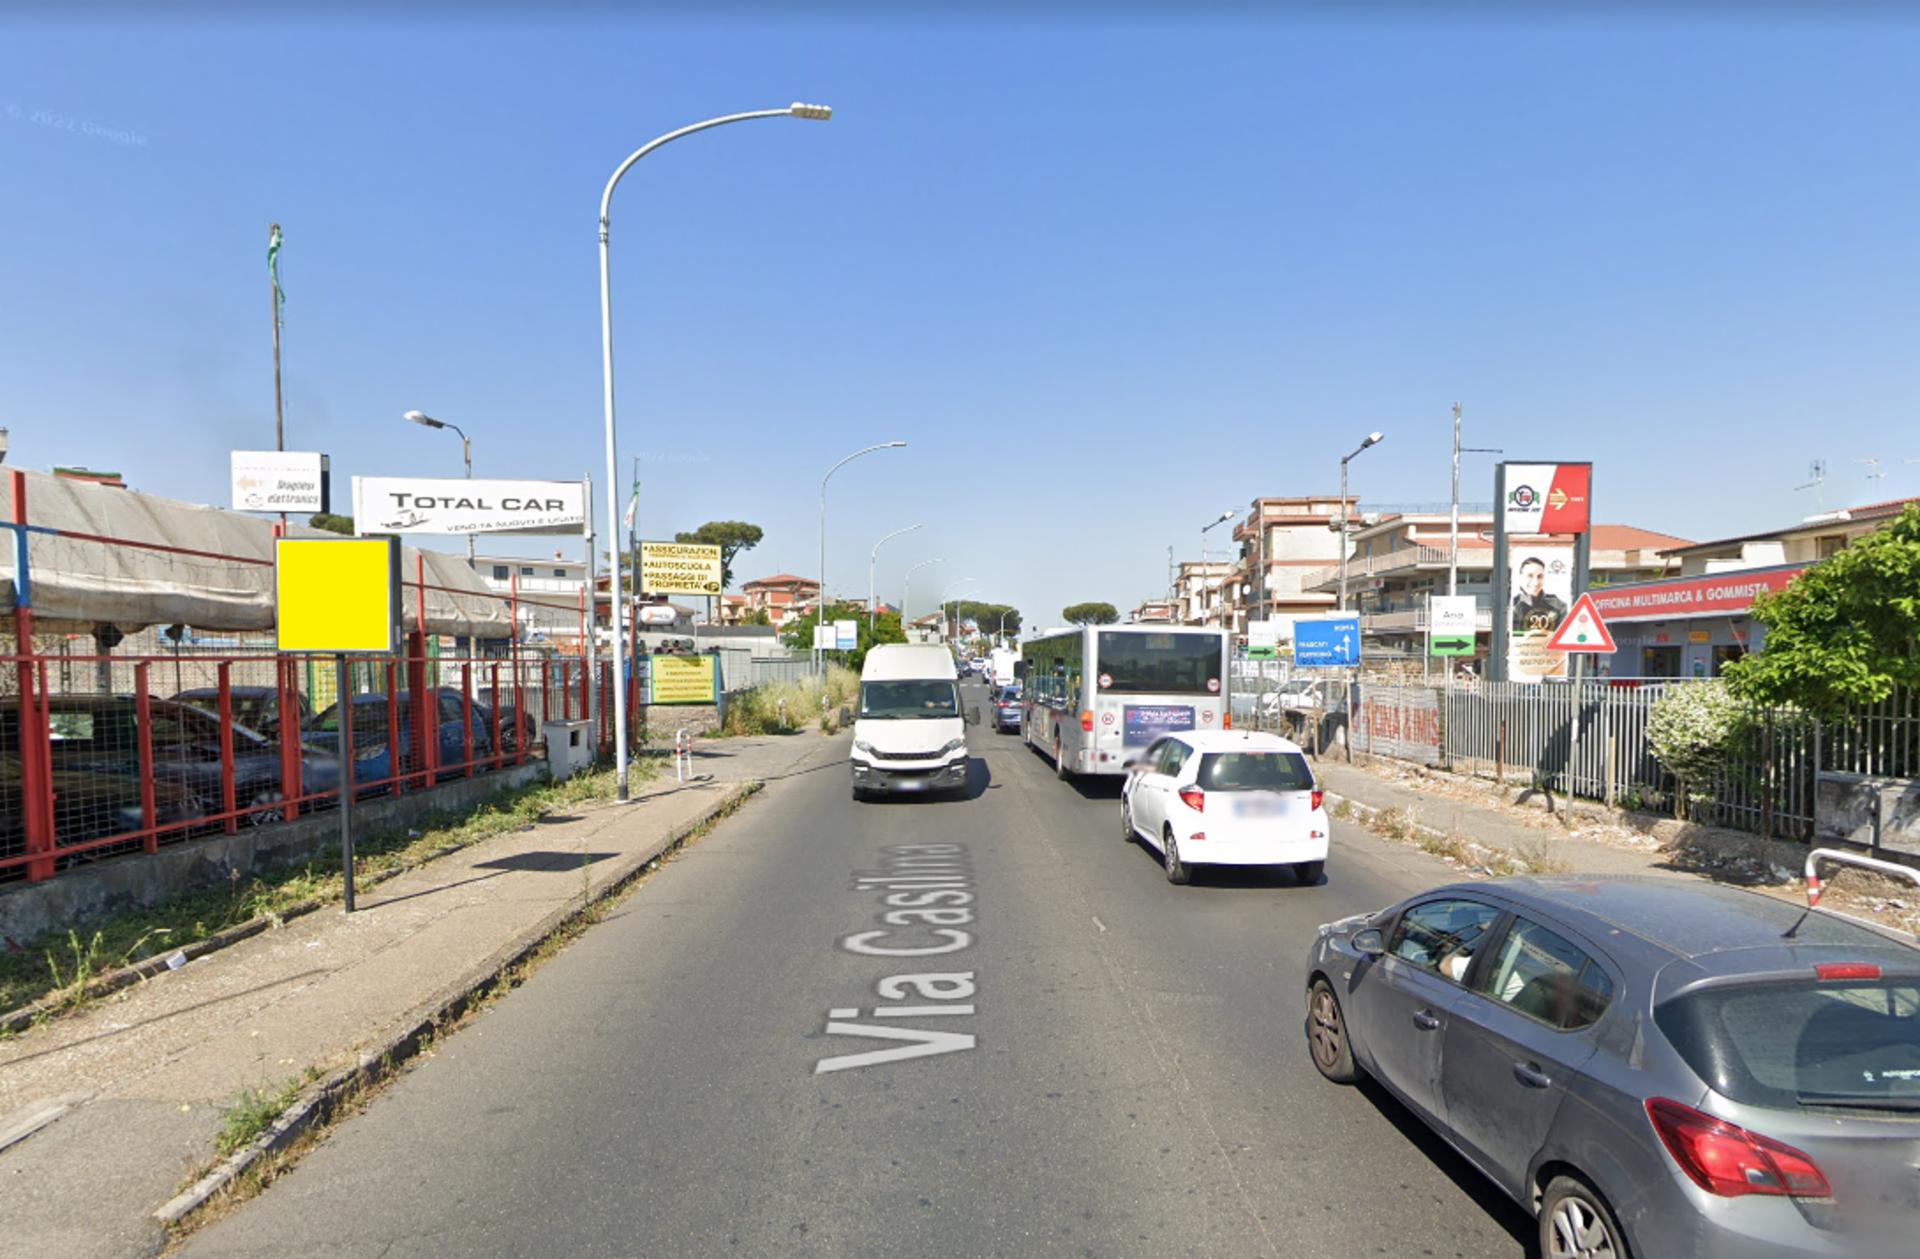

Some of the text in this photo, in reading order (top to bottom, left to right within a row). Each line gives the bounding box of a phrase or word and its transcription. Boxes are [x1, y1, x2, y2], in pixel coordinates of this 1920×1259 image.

[389, 492, 565, 513] TOTAL CAR
[649, 561, 711, 571] AUTOSCUOLA
[1633, 591, 1693, 608] MULTIMARCA
[1695, 590, 1703, 602] &
[1706, 582, 1770, 600] GOMMISTA
